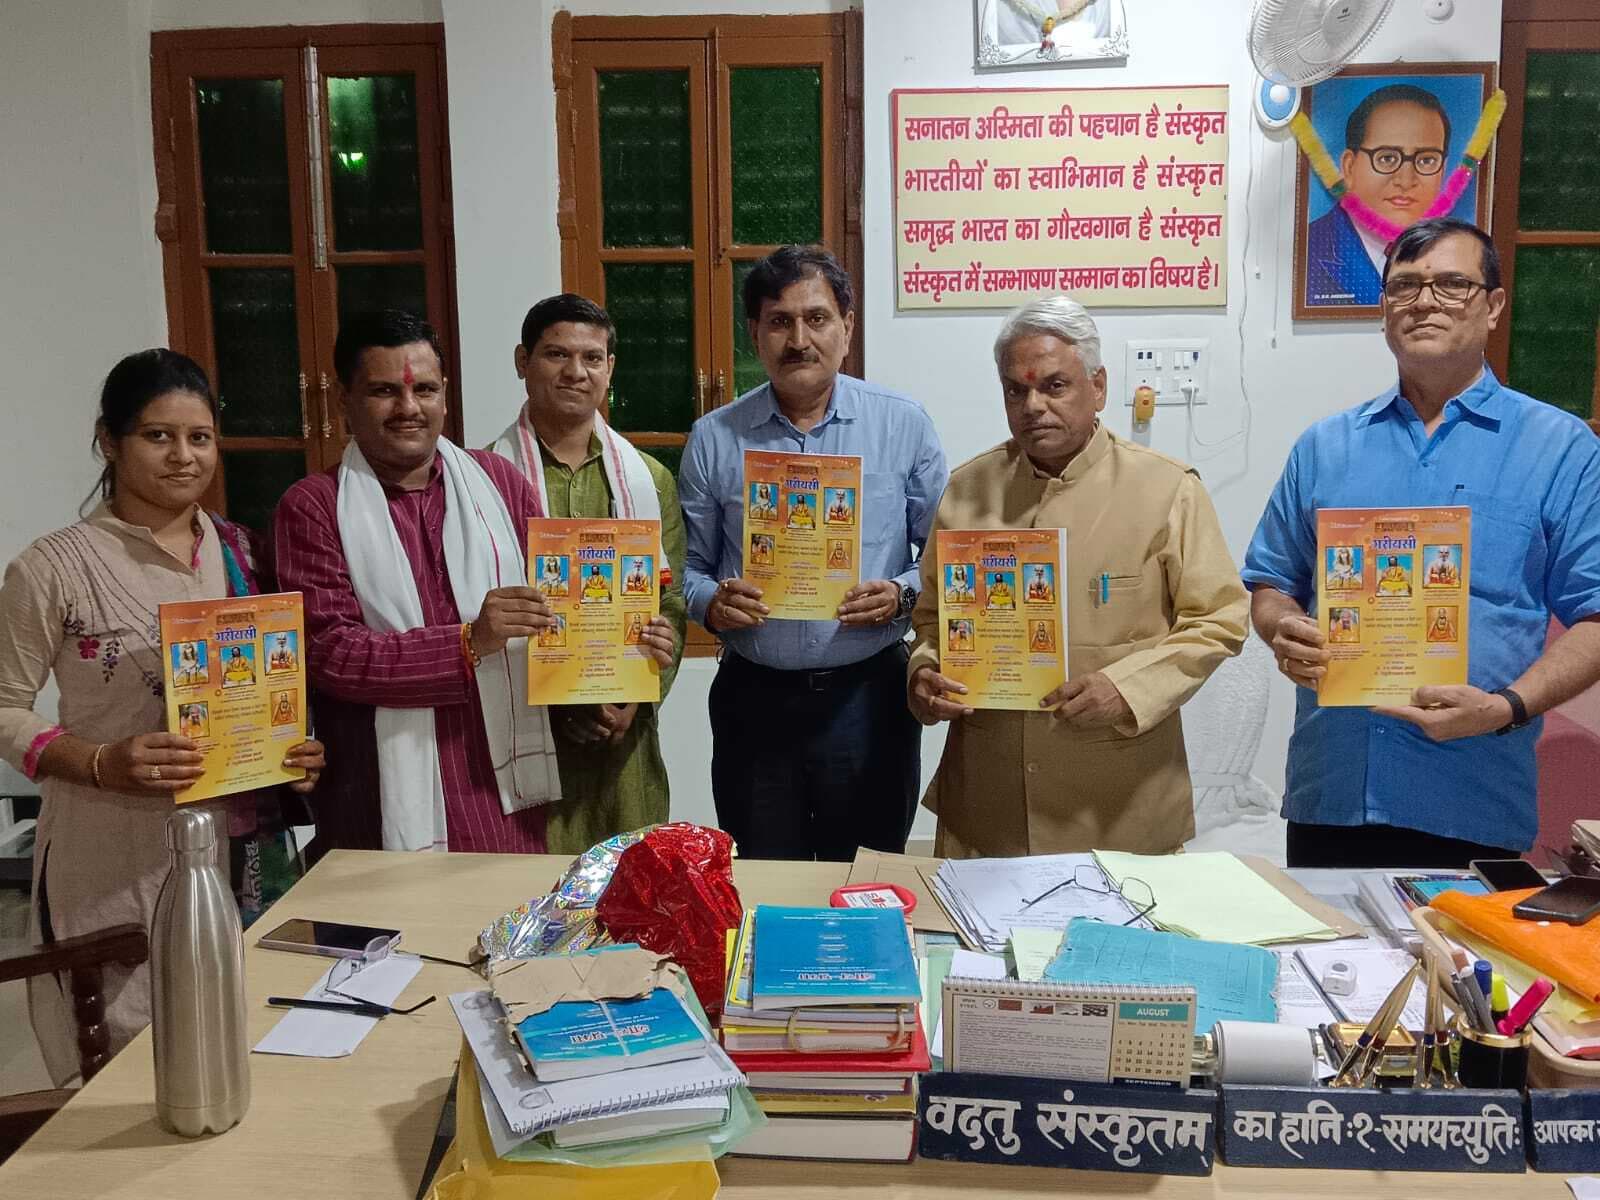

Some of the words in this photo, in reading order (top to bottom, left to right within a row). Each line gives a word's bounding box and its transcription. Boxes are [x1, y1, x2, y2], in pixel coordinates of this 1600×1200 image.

[905, 116, 971, 141] सनातन
[975, 106, 1044, 140] अस्मिता
[1048, 105, 1074, 138] की
[1079, 113, 1141, 140] पहचान
[1145, 103, 1161, 139] है
[1165, 103, 1227, 145] संस्कृत
[905, 159, 988, 192] भारतीयों
[994, 167, 1021, 190] का
[1028, 156, 1126, 190] स्वाभिमान
[1133, 155, 1149, 190] है
[1156, 155, 1224, 197] संस्कृत
[904, 220, 956, 252] समृद्ध
[962, 219, 1008, 241] भारत
[1015, 218, 1041, 240] का
[1047, 208, 1131, 240] गौरवगान
[1138, 206, 1153, 241] है
[1160, 207, 1222, 247] संस्कृत
[904, 263, 962, 302] संस्कृत
[965, 262, 983, 292] में
[983, 269, 1057, 292] सम्भाषण
[1059, 268, 1120, 291] सम्मान
[1122, 267, 1147, 289] का
[1150, 257, 1195, 289] विषय
[1136, 1008, 1169, 1016] AUGUST
[926, 1095, 1021, 1156] वदतु
[1233, 1111, 1277, 1142] का
[1534, 1119, 1595, 1144] आपका
